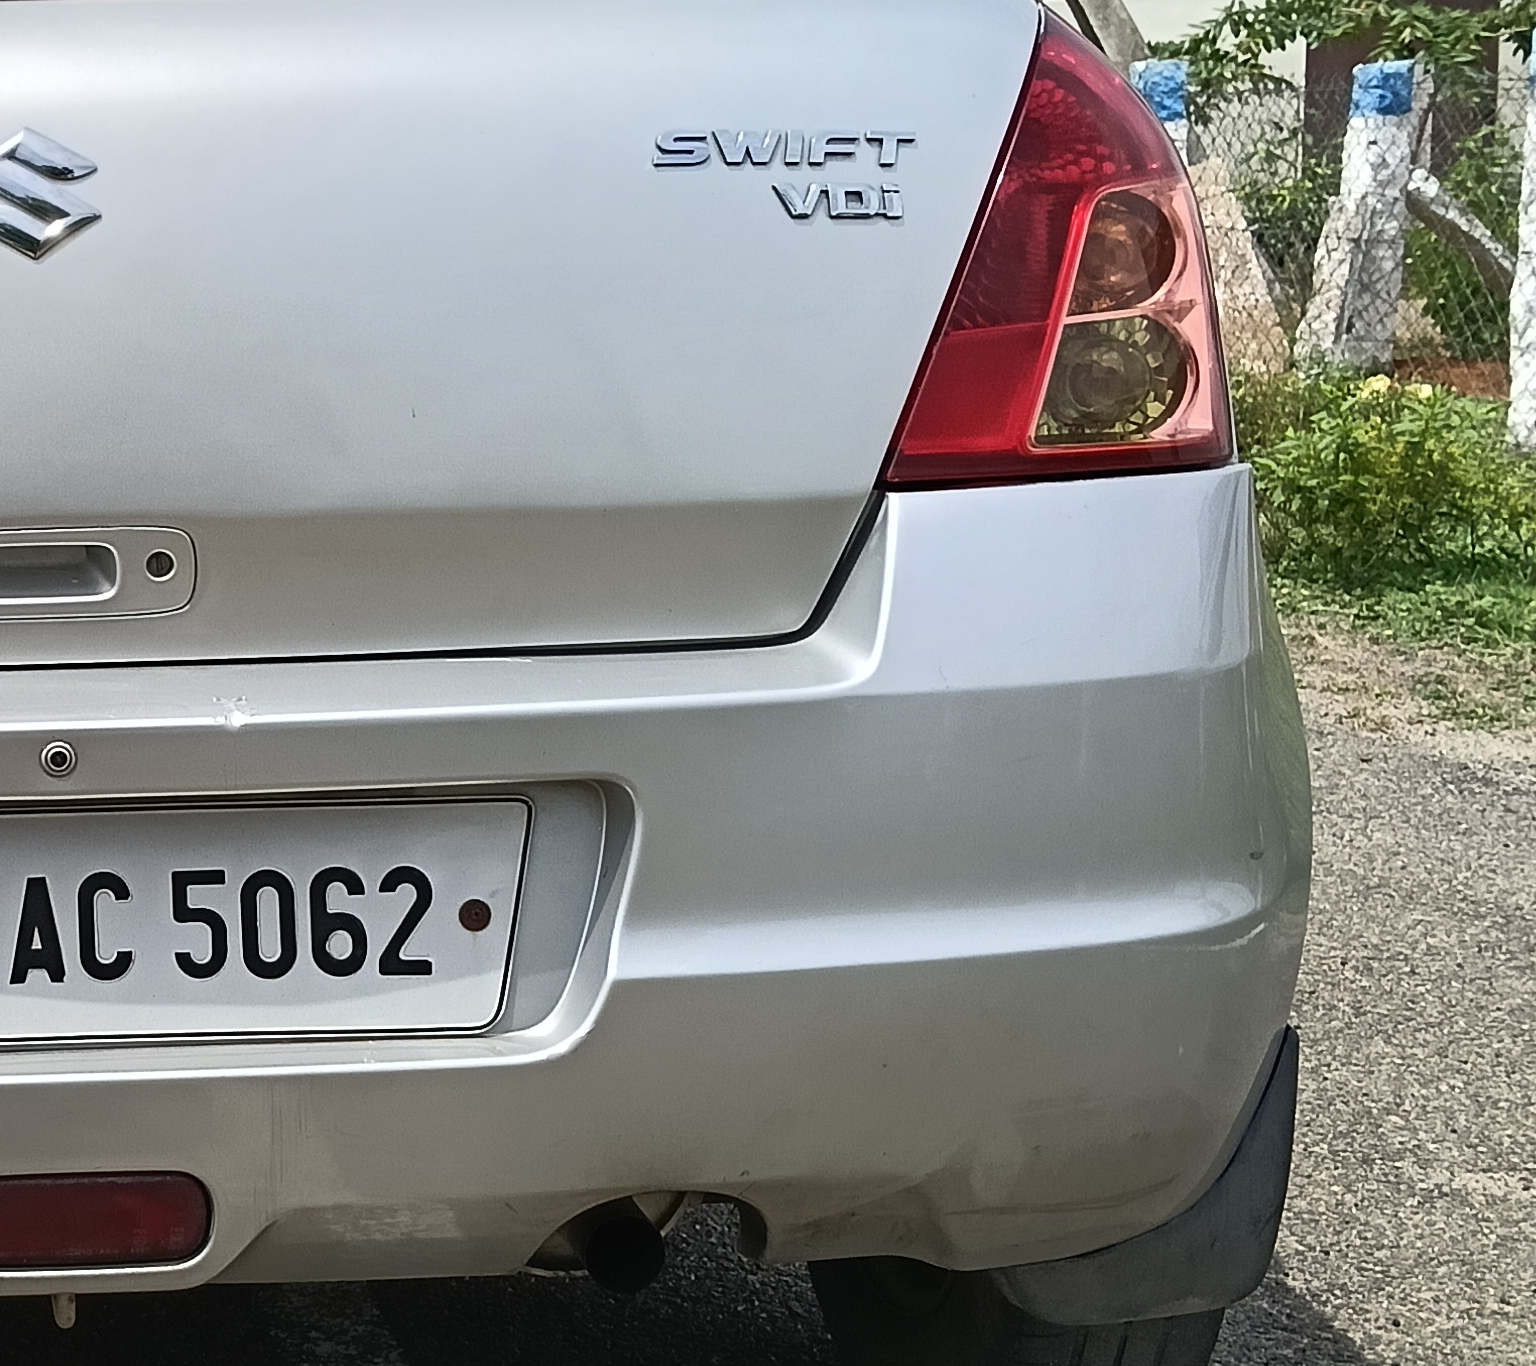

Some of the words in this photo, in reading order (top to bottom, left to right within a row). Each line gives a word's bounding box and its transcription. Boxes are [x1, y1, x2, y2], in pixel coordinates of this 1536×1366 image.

[652, 130, 917, 169] SWIFT
[8, 869, 135, 985] AC
[170, 865, 434, 981] 5062
